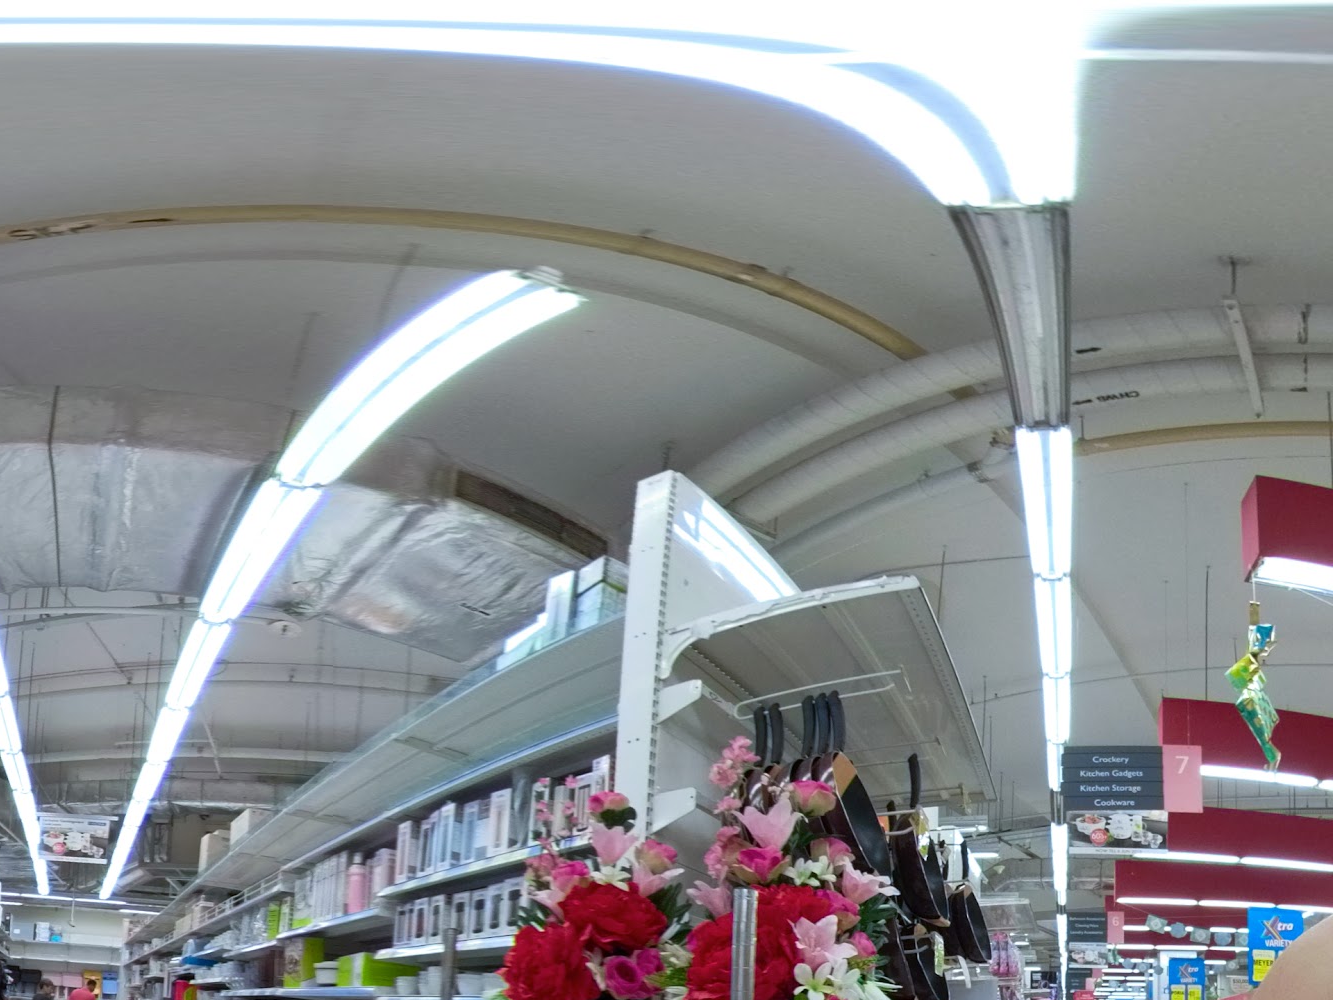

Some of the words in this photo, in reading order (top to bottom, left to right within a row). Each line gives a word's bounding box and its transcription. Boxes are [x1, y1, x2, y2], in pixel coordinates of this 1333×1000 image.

[1092, 756, 1130, 764] Crockery
[1175, 755, 1190, 775] 7
[1079, 770, 1110, 778] Kitchen
[1111, 770, 1144, 779] Gadgets
[1079, 784, 1110, 792] Kitchen
[1111, 784, 1142, 793] Storage
[1093, 799, 1136, 807] Cookware
[1260, 915, 1294, 940] Xtra
